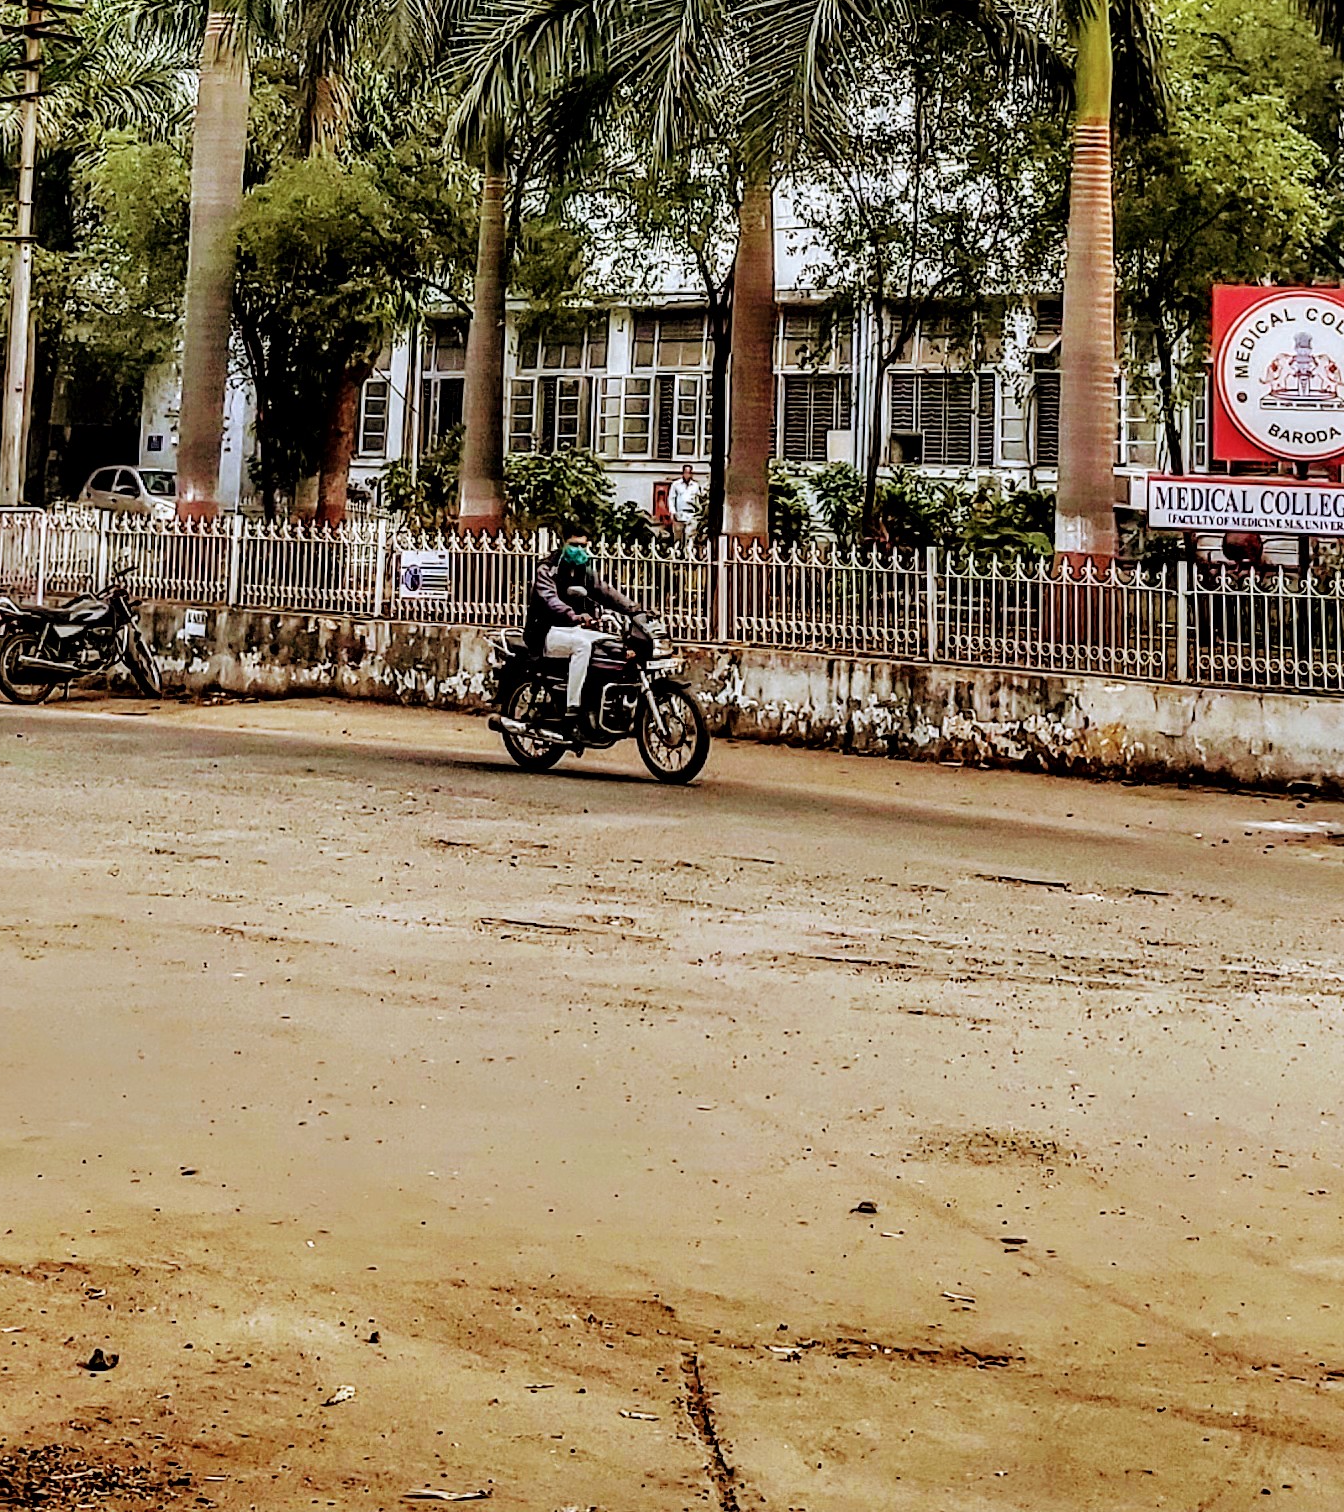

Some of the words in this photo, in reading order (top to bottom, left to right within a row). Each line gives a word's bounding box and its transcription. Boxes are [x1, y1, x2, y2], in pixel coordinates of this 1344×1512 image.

[1235, 309, 1296, 378] MEDICAL
[1268, 424, 1341, 443] BARODA
[1154, 486, 1253, 514] MEDICAL
[1216, 516, 1230, 526] OF
